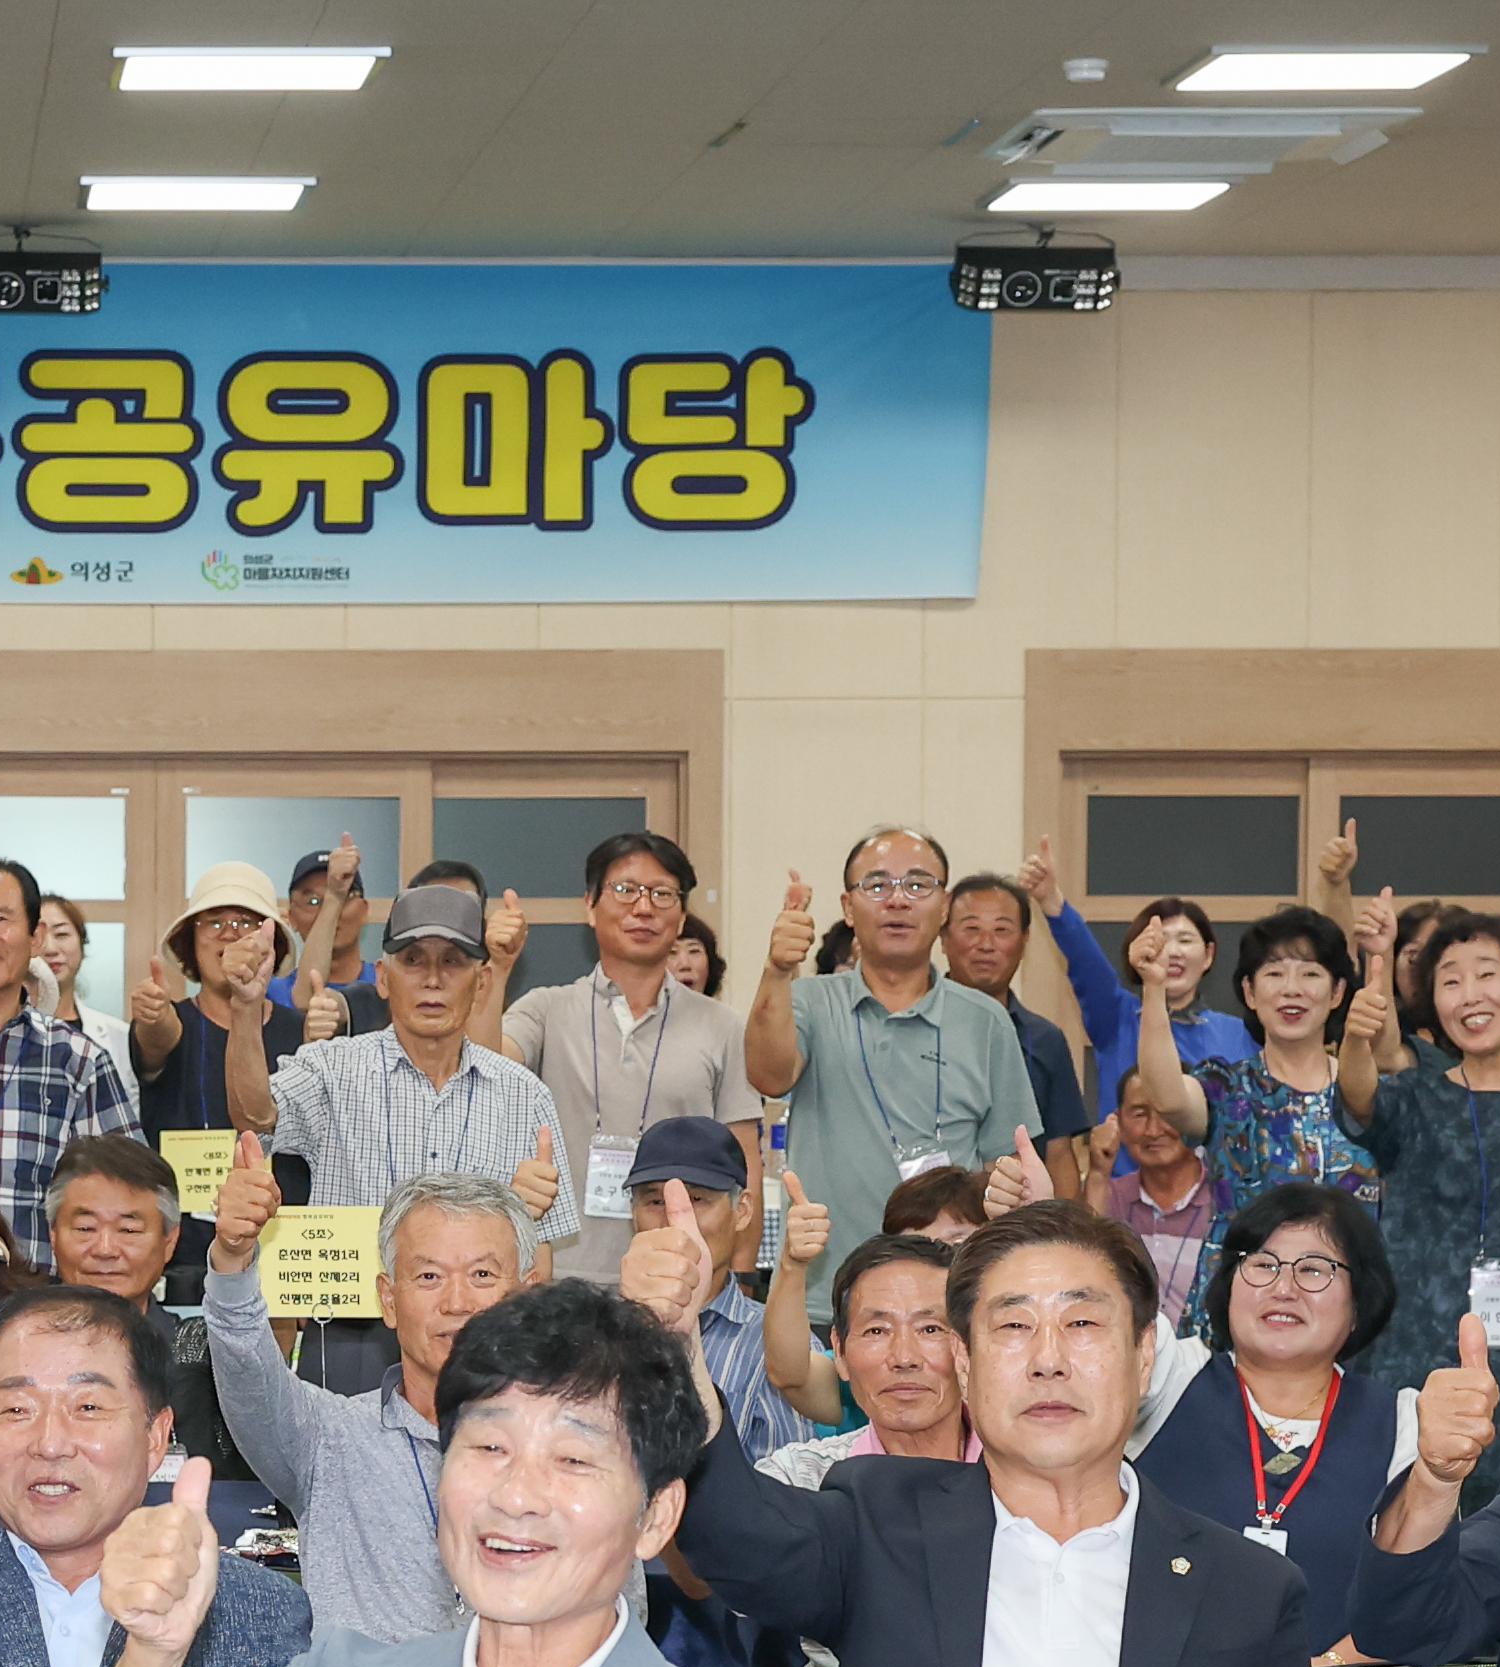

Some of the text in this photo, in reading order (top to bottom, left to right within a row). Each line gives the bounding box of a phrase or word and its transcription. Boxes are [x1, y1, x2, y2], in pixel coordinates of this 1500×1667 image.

[70, 560, 135, 583] 의성군
[301, 1229, 334, 1240] <5조>
[279, 1271, 312, 1283] 비안면
